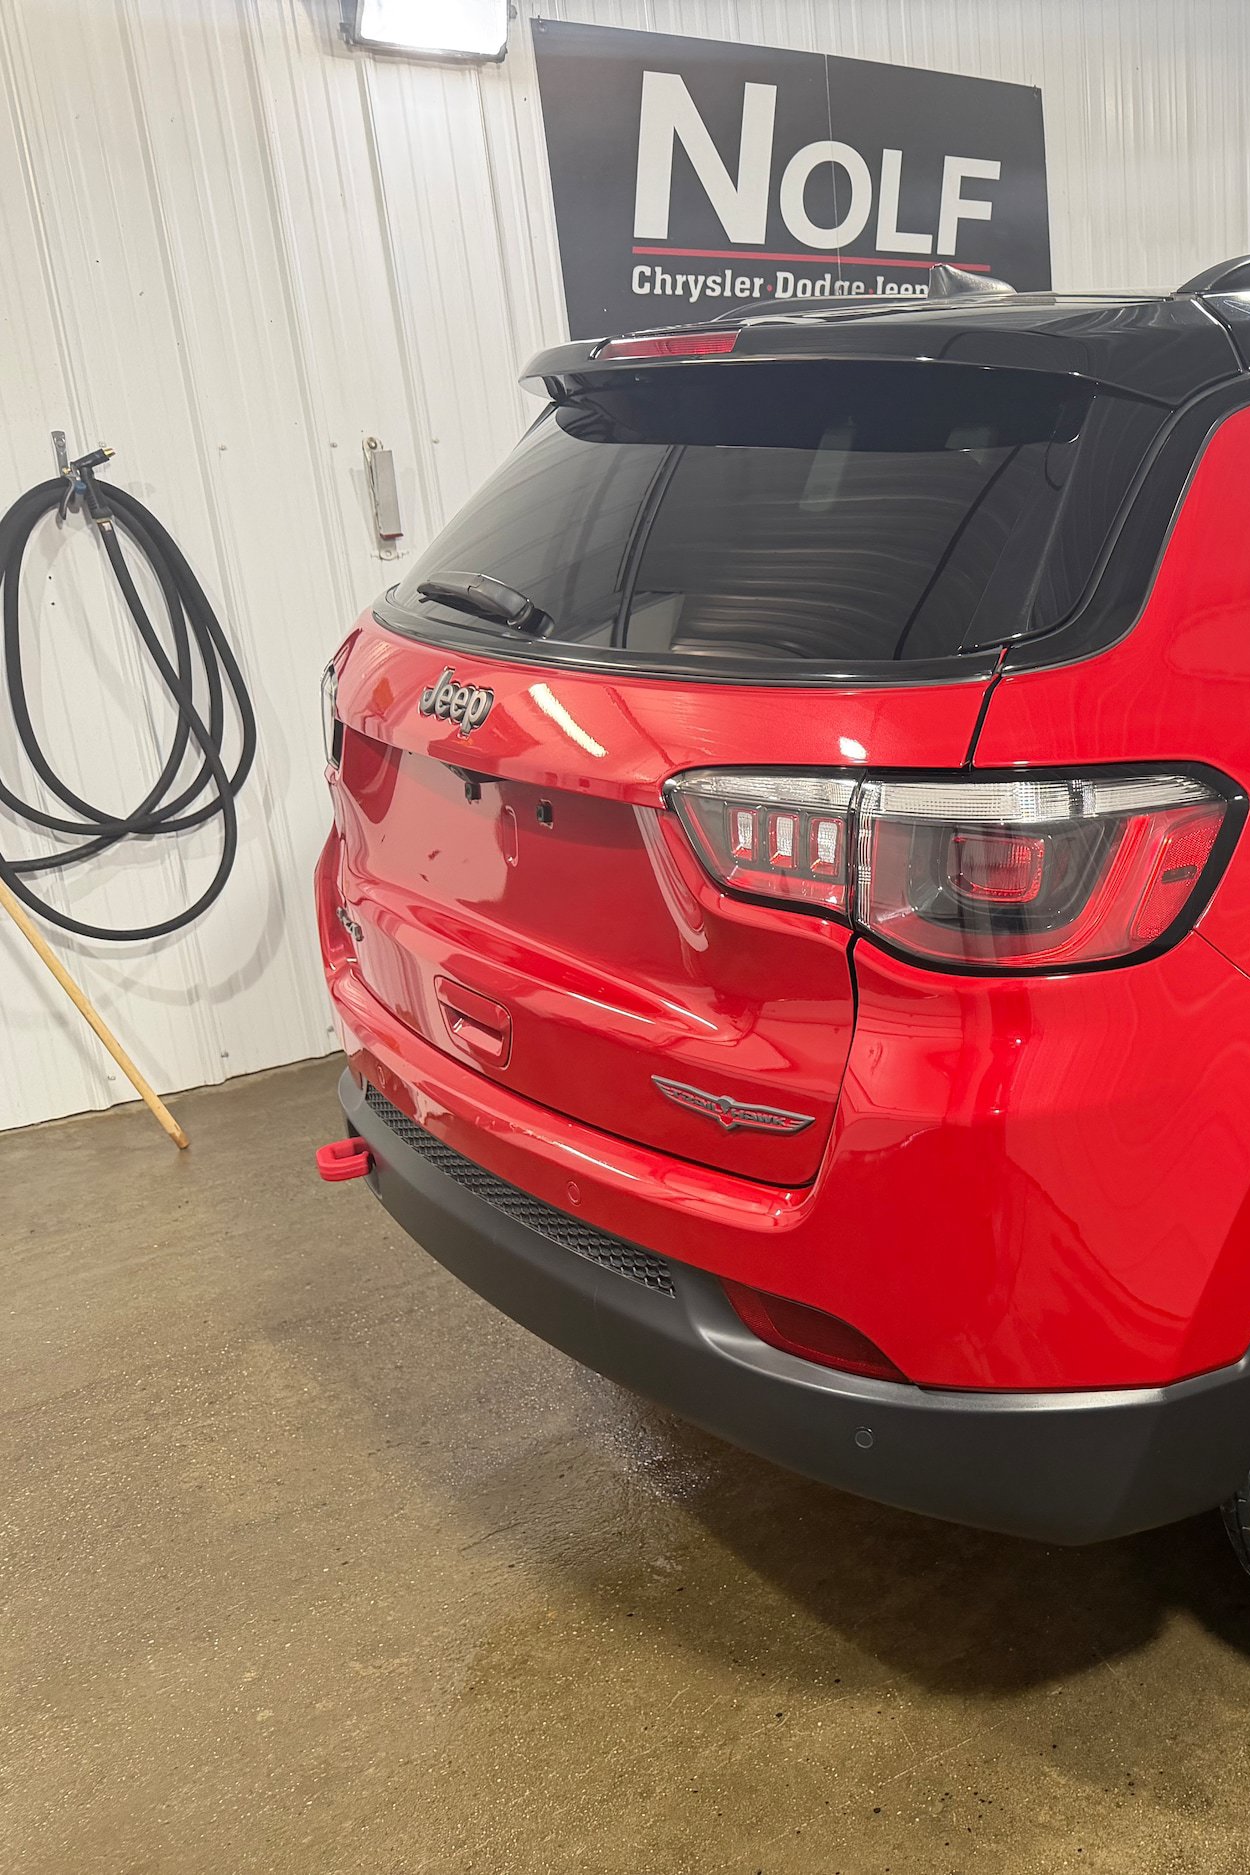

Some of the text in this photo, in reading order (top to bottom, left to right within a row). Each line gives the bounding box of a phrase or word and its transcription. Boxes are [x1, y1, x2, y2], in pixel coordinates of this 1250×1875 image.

[633, 70, 1001, 256] NOLF
[631, 264, 764, 303] Chrysler
[418, 666, 495, 738] Jeep
